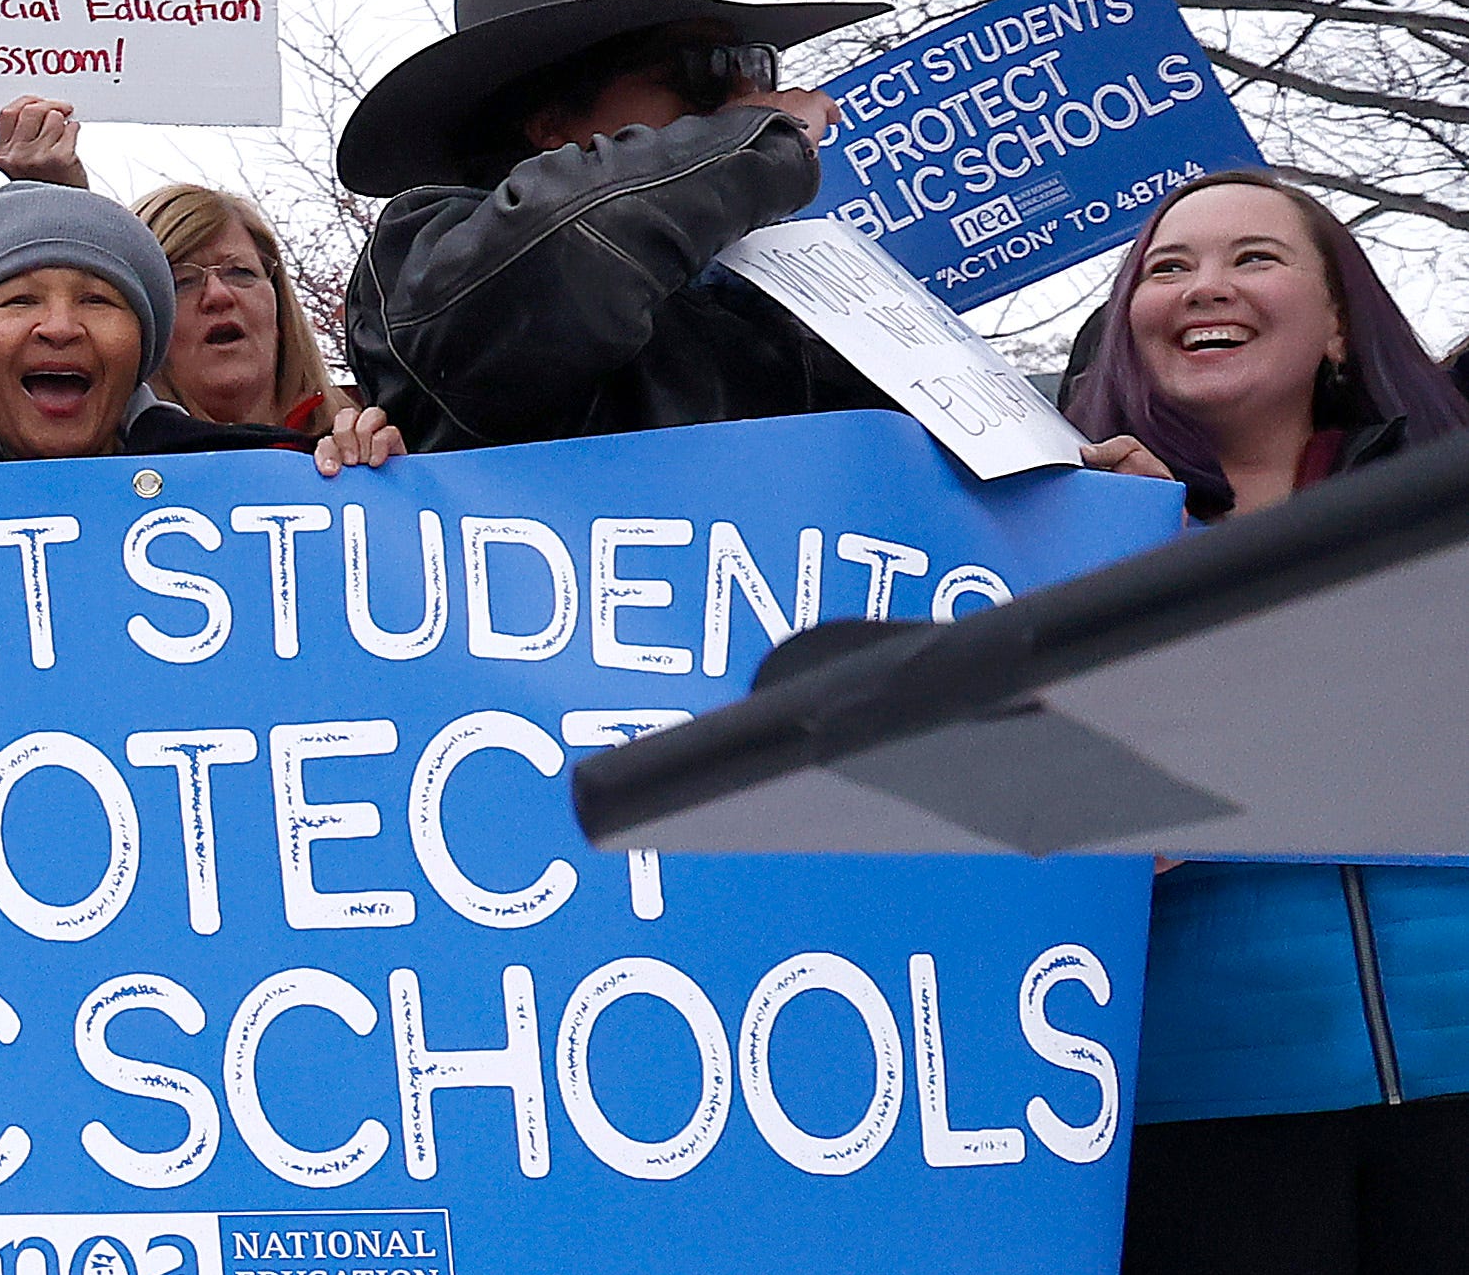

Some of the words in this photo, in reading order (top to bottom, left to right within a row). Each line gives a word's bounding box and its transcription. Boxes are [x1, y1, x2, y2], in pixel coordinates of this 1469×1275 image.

[845, 50, 1070, 187] PROTECT
[955, 54, 1204, 194] SCHOOLS
[936, 221, 1059, 290] "ACTION"
[1065, 202, 1110, 234] TO
[1116, 161, 1205, 209] 48744
[958, 198, 1015, 242] nea
[75, 942, 1120, 1190] SCHOOLS
[233, 1231, 436, 1259] NATIONAL
